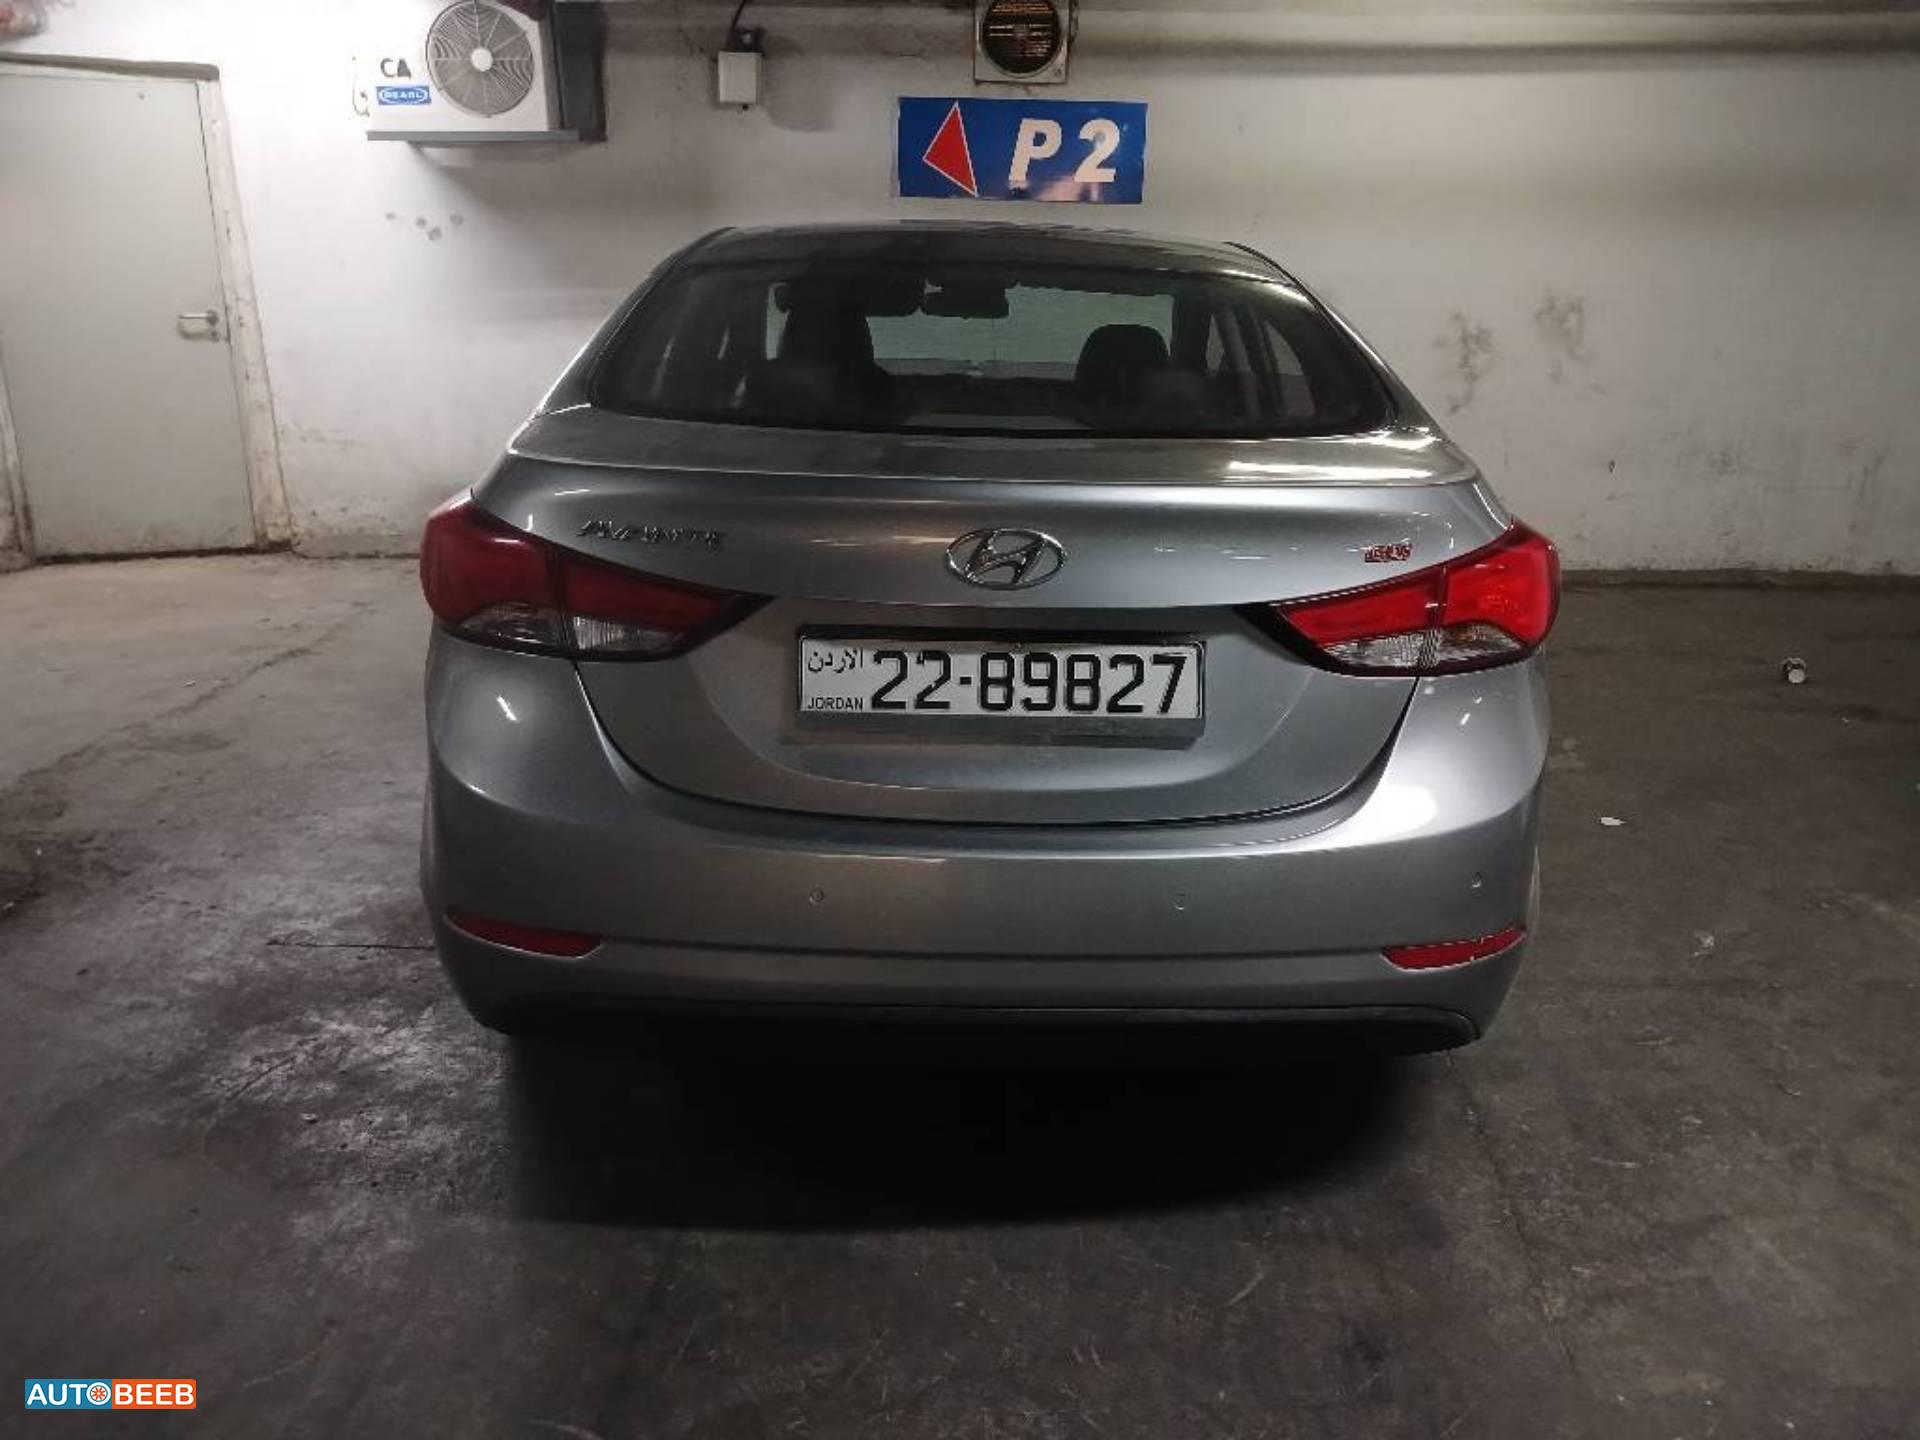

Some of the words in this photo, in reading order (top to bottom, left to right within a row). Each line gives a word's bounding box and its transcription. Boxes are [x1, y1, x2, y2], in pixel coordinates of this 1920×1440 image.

[1008, 118, 1062, 181] P
[1073, 118, 1121, 183] 2
[807, 696, 863, 711] JORDAN
[871, 650, 1187, 714] 22-89827
